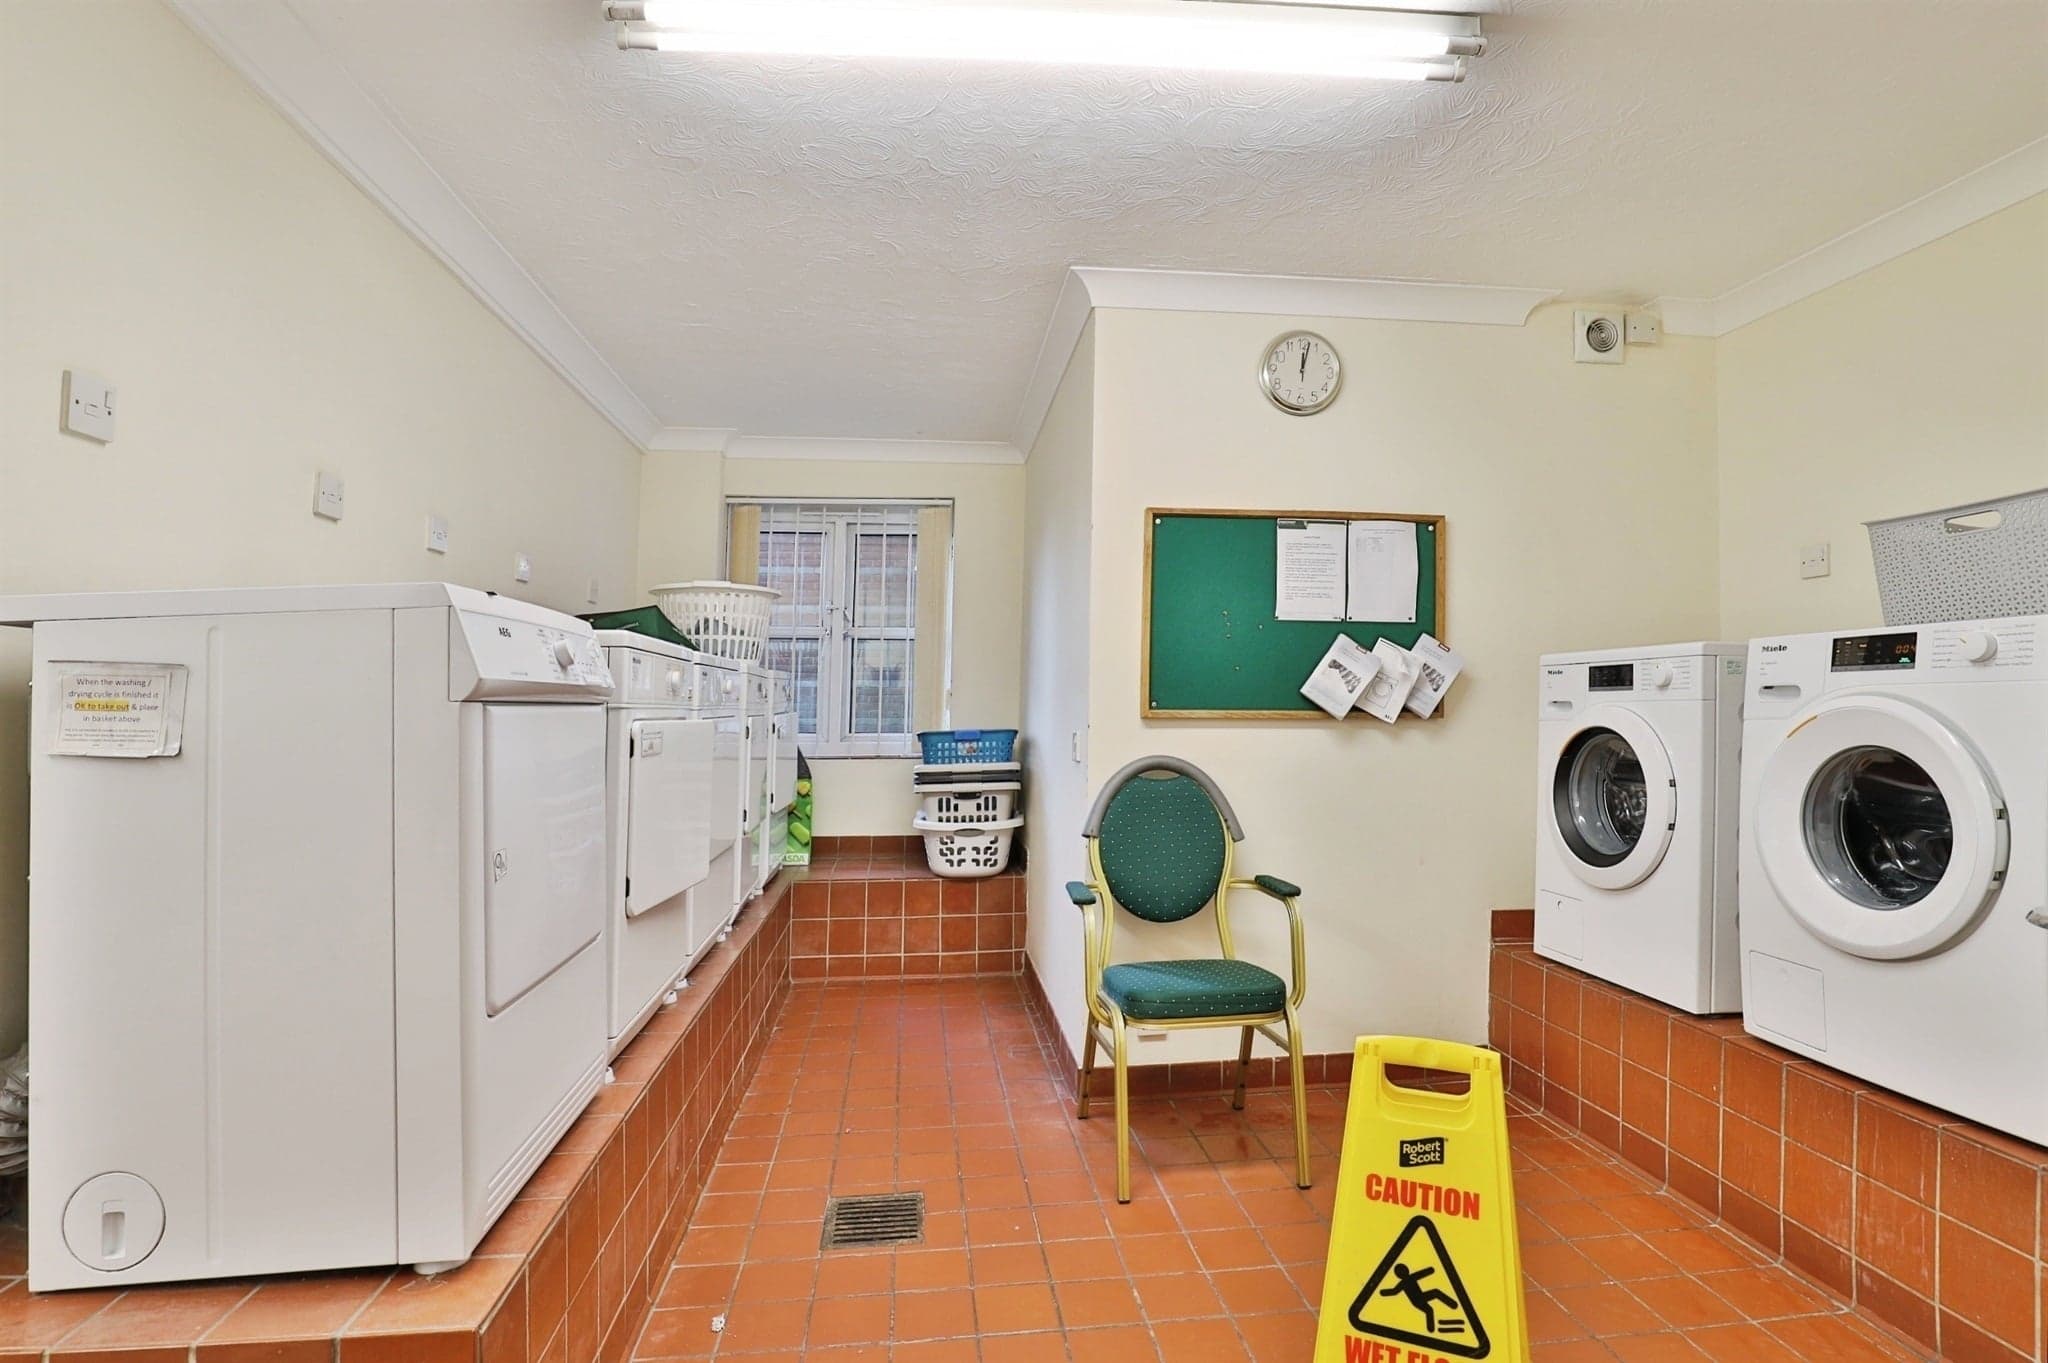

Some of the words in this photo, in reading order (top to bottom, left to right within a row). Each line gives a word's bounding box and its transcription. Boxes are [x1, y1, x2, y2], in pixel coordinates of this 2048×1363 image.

[1286, 341, 1294, 352] 11
[1315, 343, 1319, 352] 1
[1322, 353, 1331, 366] 2
[1327, 367, 1334, 379] 3
[1273, 378, 1282, 390] 8
[1321, 382, 1329, 393] 4
[1285, 389, 1292, 400] 7
[1297, 394, 1305, 404] 6
[1311, 391, 1318, 402] 5
[76, 678, 100, 686] When
[114, 679, 146, 688] washing
[68, 690, 92, 699] drying
[74, 702, 86, 710] OK
[1402, 1140, 1441, 1155] Robert
[1409, 1150, 1441, 1165] Scott
[1365, 1173, 1480, 1221] CAUTION
[1345, 1335, 1401, 1363] WET
